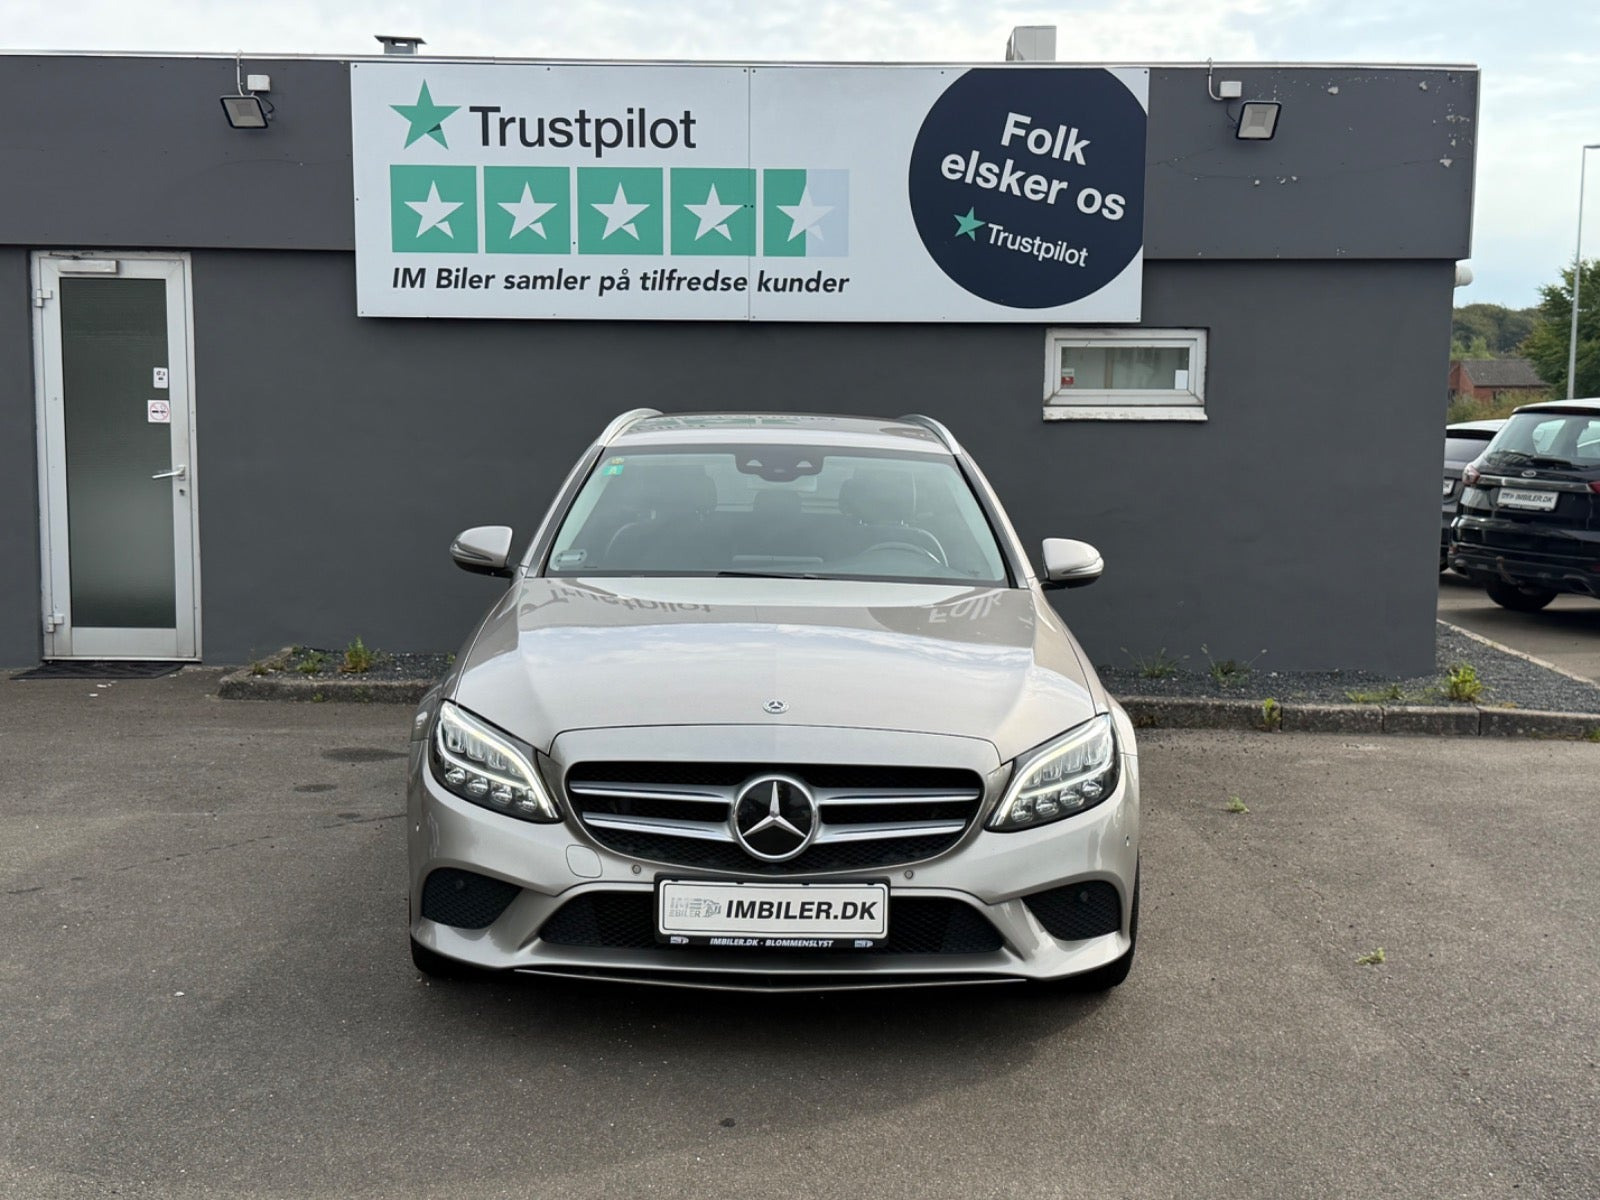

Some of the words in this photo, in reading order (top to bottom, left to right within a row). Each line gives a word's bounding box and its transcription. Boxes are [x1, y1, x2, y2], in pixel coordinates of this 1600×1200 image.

[469, 106, 697, 158] Trustpilot
[1000, 111, 1091, 166] Folk
[940, 150, 1069, 205] elsker
[1076, 187, 1126, 221] os
[987, 222, 1089, 268] Trustpilot
[392, 267, 427, 289] IM
[435, 267, 496, 290] Biler
[503, 268, 590, 291] samler
[597, 268, 631, 297] på
[639, 269, 748, 293] tilfredse
[757, 270, 850, 294] kunder
[726, 900, 878, 921] IMBILER.DK
[709, 938, 758, 947] IMBILER.DK
[765, 939, 834, 948] BLOMMENSLYST
